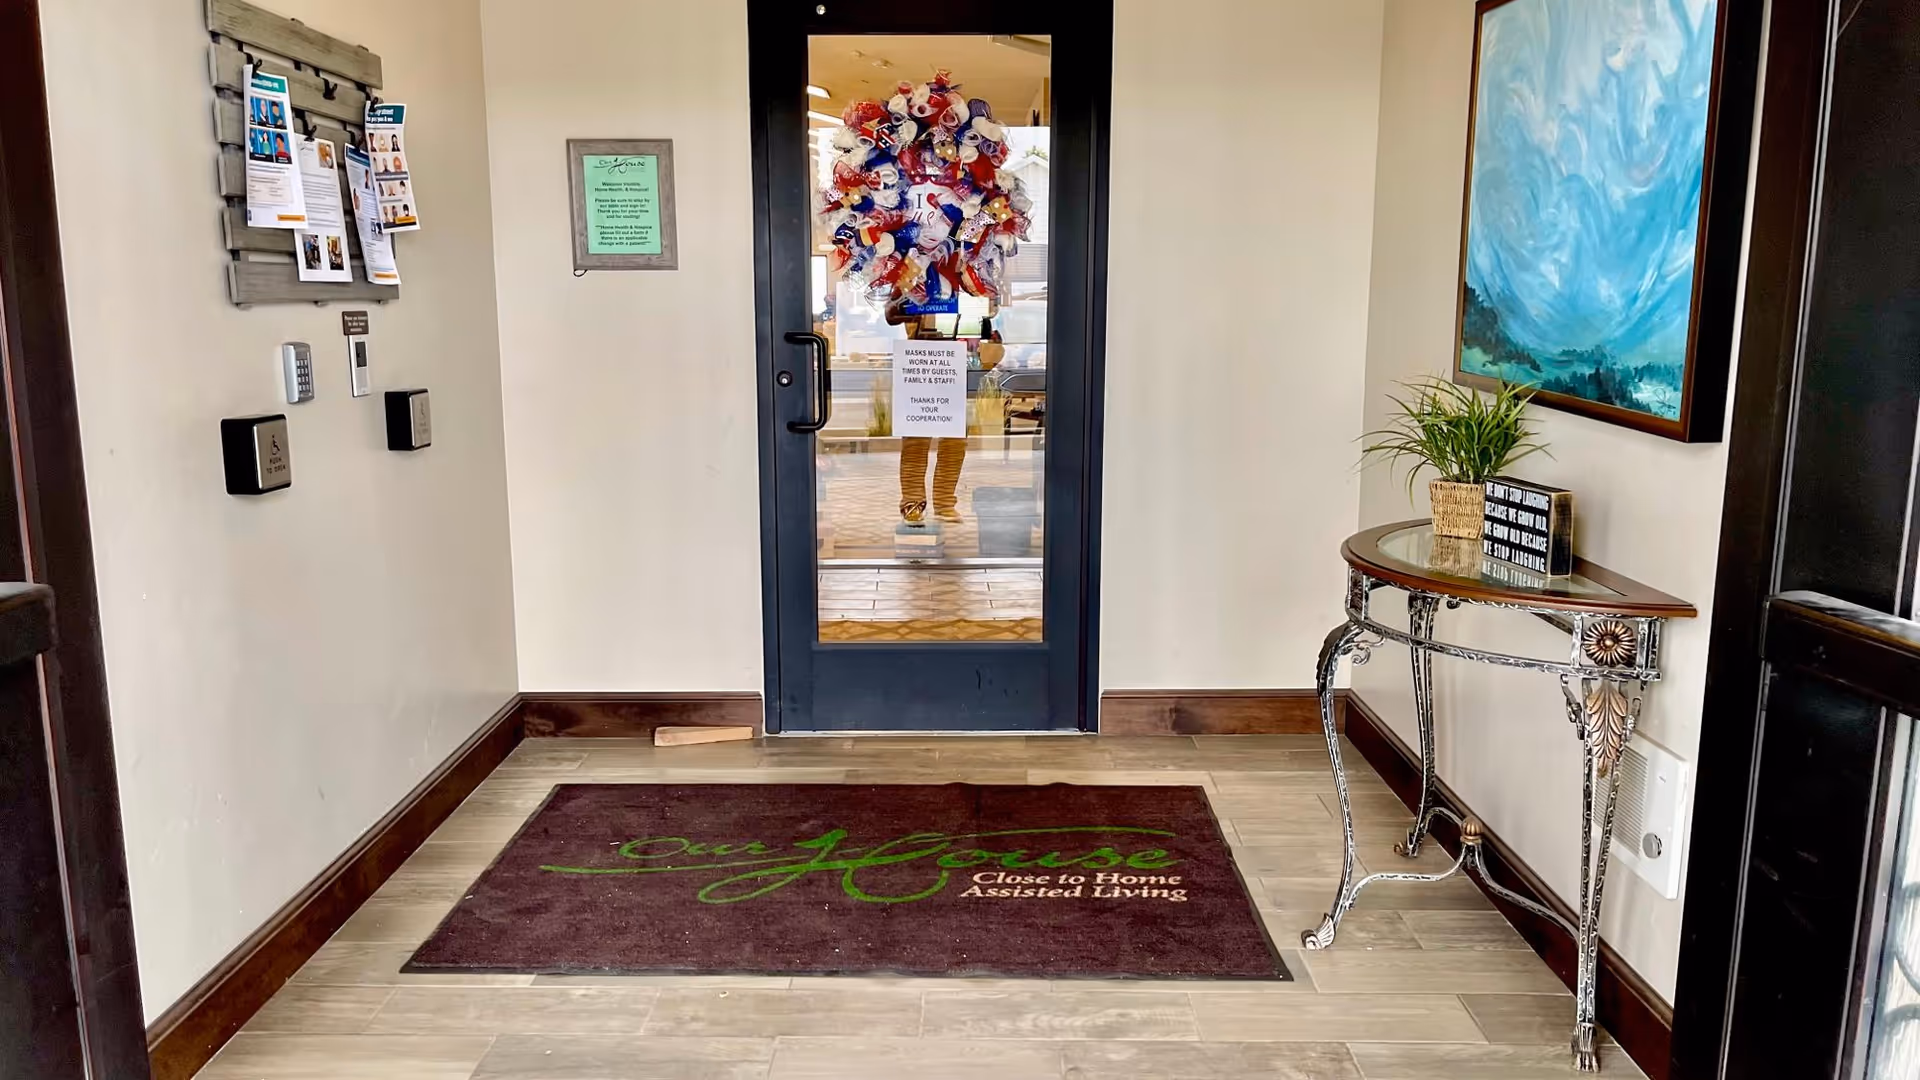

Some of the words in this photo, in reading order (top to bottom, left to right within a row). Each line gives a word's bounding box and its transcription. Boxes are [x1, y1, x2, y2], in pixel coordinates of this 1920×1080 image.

[931, 368, 958, 377] GUESTS,
[1486, 481, 1494, 497] WE
[1494, 483, 1509, 500] DON'T
[1510, 487, 1522, 504] STOP
[1485, 500, 1508, 520] BECAUSE
[1508, 508, 1517, 523] WE
[1518, 510, 1535, 528] GROW
[1535, 514, 1548, 533] OLD,
[1484, 520, 1492, 536] WE
[1492, 522, 1510, 540] GROW
[1510, 528, 1520, 544] OLD
[1521, 531, 1548, 552] BECAUSE
[1483, 540, 1492, 555] WE
[1494, 543, 1510, 560] STOP
[1512, 548, 1546, 573] LAUGHING.
[617, 835, 775, 860] Our
[697, 826, 1186, 904] House
[971, 871, 1049, 886] Close
[1057, 872, 1086, 886] to
[1091, 871, 1183, 886] Home
[959, 885, 1084, 899] Assisted
[1089, 884, 1189, 902] Living
